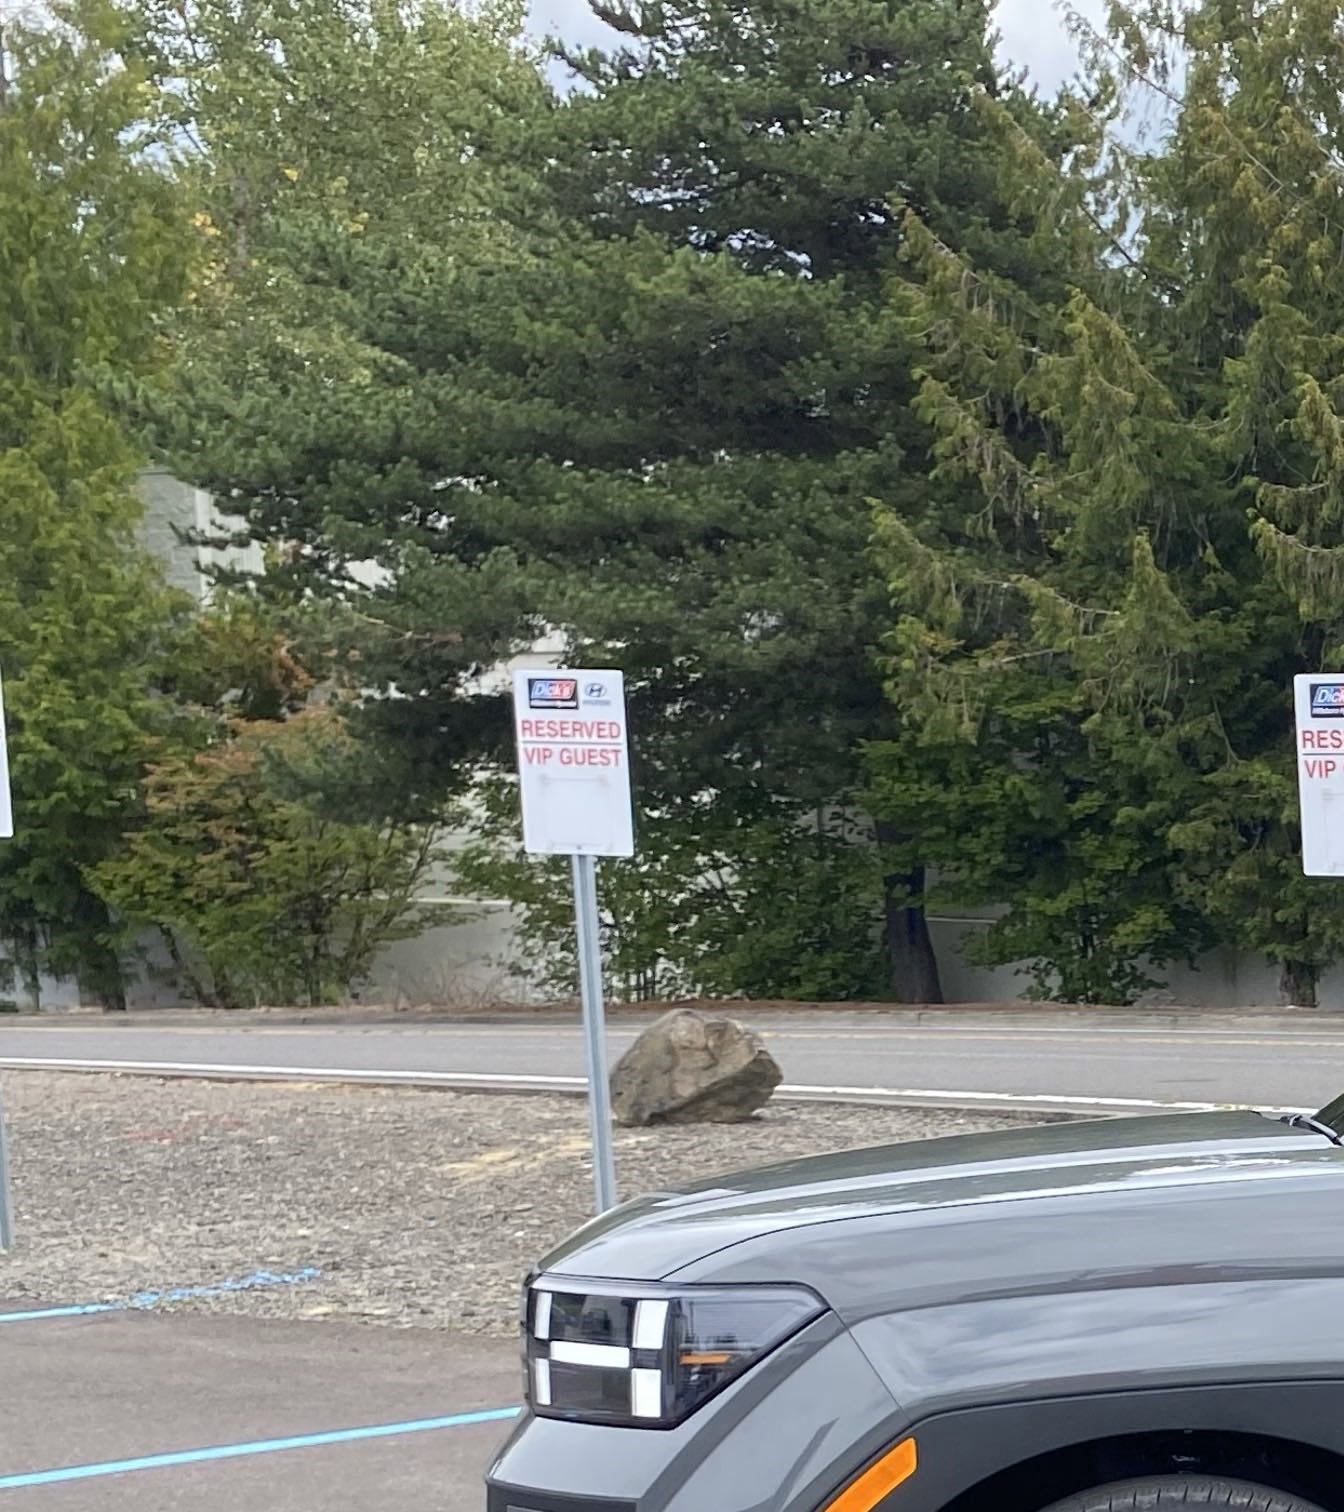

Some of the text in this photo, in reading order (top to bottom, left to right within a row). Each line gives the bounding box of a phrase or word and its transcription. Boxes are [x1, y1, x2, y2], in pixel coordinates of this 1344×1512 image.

[521, 720, 621, 739] RESERVED
[523, 748, 622, 767] VIP GUEST
[1304, 760, 1336, 779] VIP
